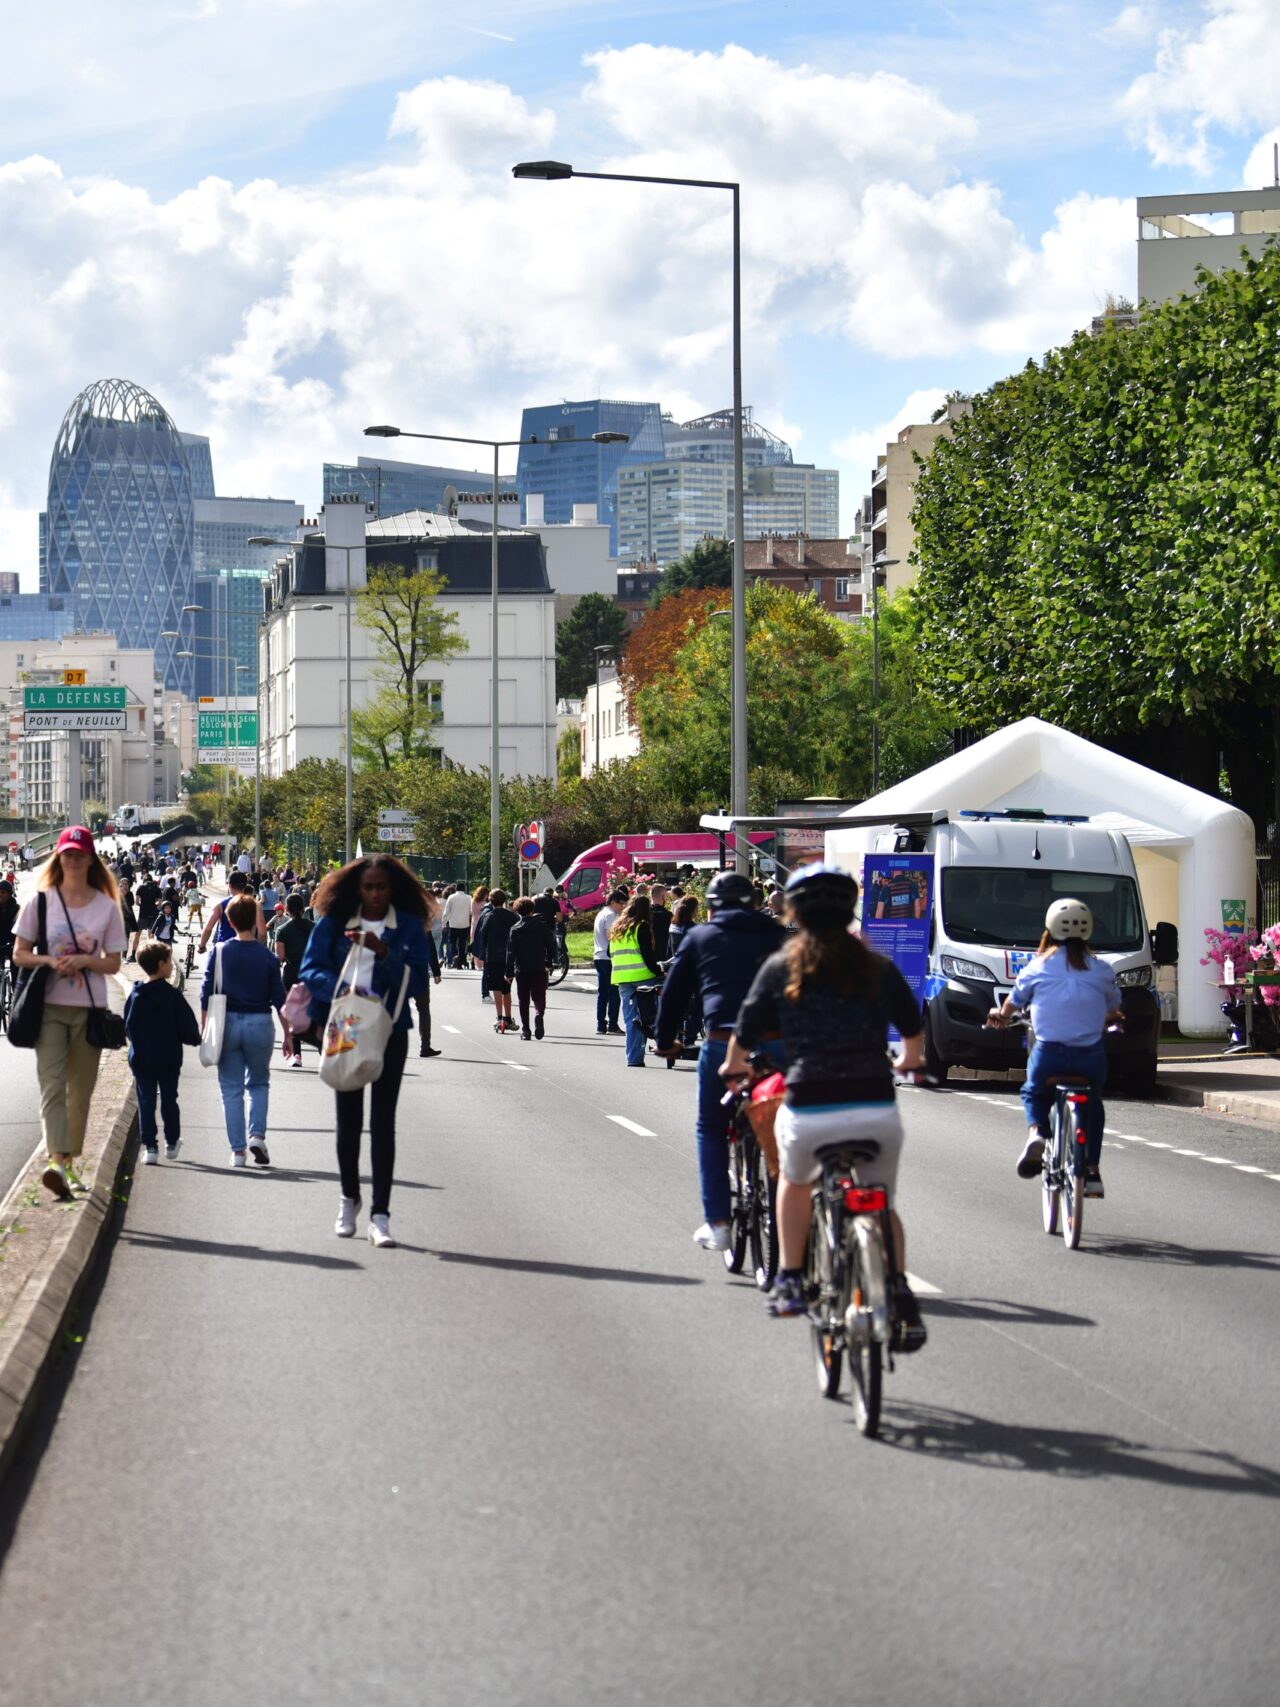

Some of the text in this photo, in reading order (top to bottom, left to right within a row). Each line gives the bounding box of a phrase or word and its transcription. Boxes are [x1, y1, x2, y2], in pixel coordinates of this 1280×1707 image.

[67, 673, 82, 681] D 7
[30, 690, 121, 704] LA DÉFENSE
[29, 717, 58, 726] PONT
[76, 717, 121, 726] NEUILLY
